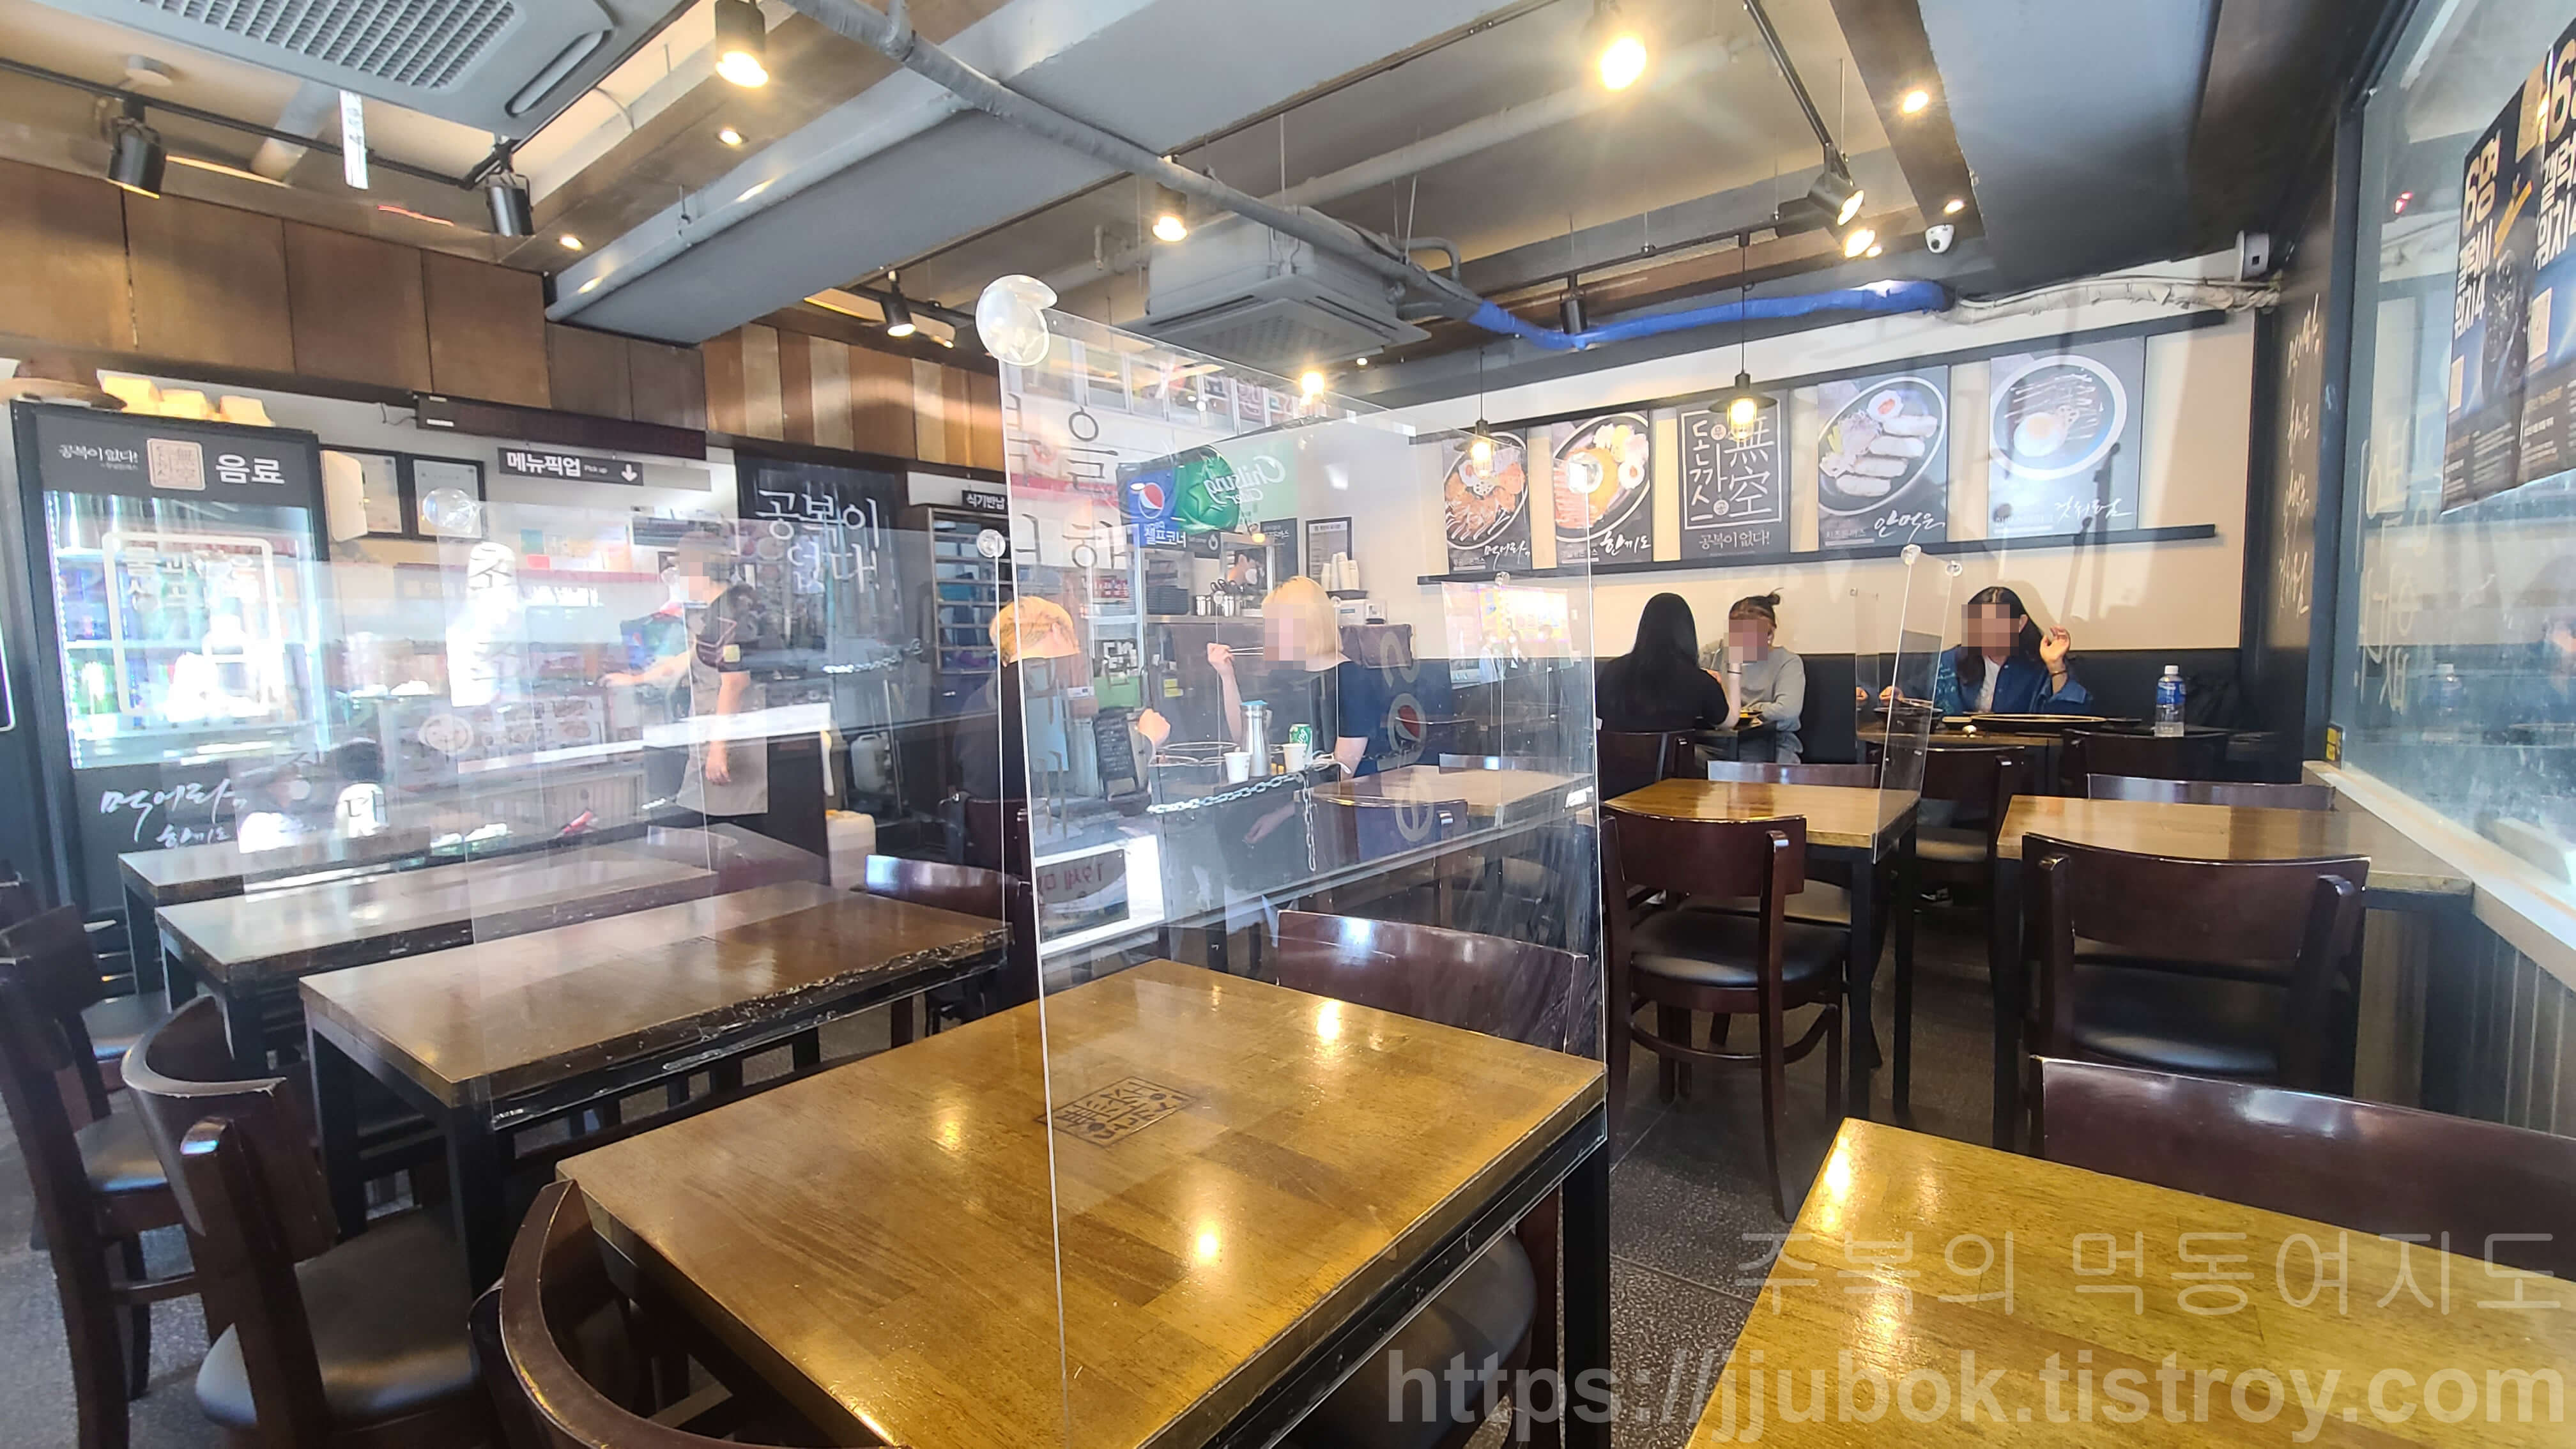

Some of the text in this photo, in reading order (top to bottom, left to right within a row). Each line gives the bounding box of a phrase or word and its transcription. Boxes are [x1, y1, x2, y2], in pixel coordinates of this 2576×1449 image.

[2547, 38, 2576, 142] 6
[2462, 128, 2501, 237] 6명
[2540, 130, 2576, 215] 갤럭
[2457, 218, 2493, 293] 갤럭시
[2455, 272, 2486, 339] 워치4
[215, 454, 285, 485] 음료
[507, 452, 581, 477] 메뉴픽업
[1689, 420, 1727, 521] 돈까스
[755, 489, 879, 548] 공복이
[966, 493, 1005, 510] 식기반납
[1873, 509, 1945, 542] 안먹은
[1600, 531, 1651, 556] 한끼도
[1698, 529, 1770, 550] 공복이 없다!
